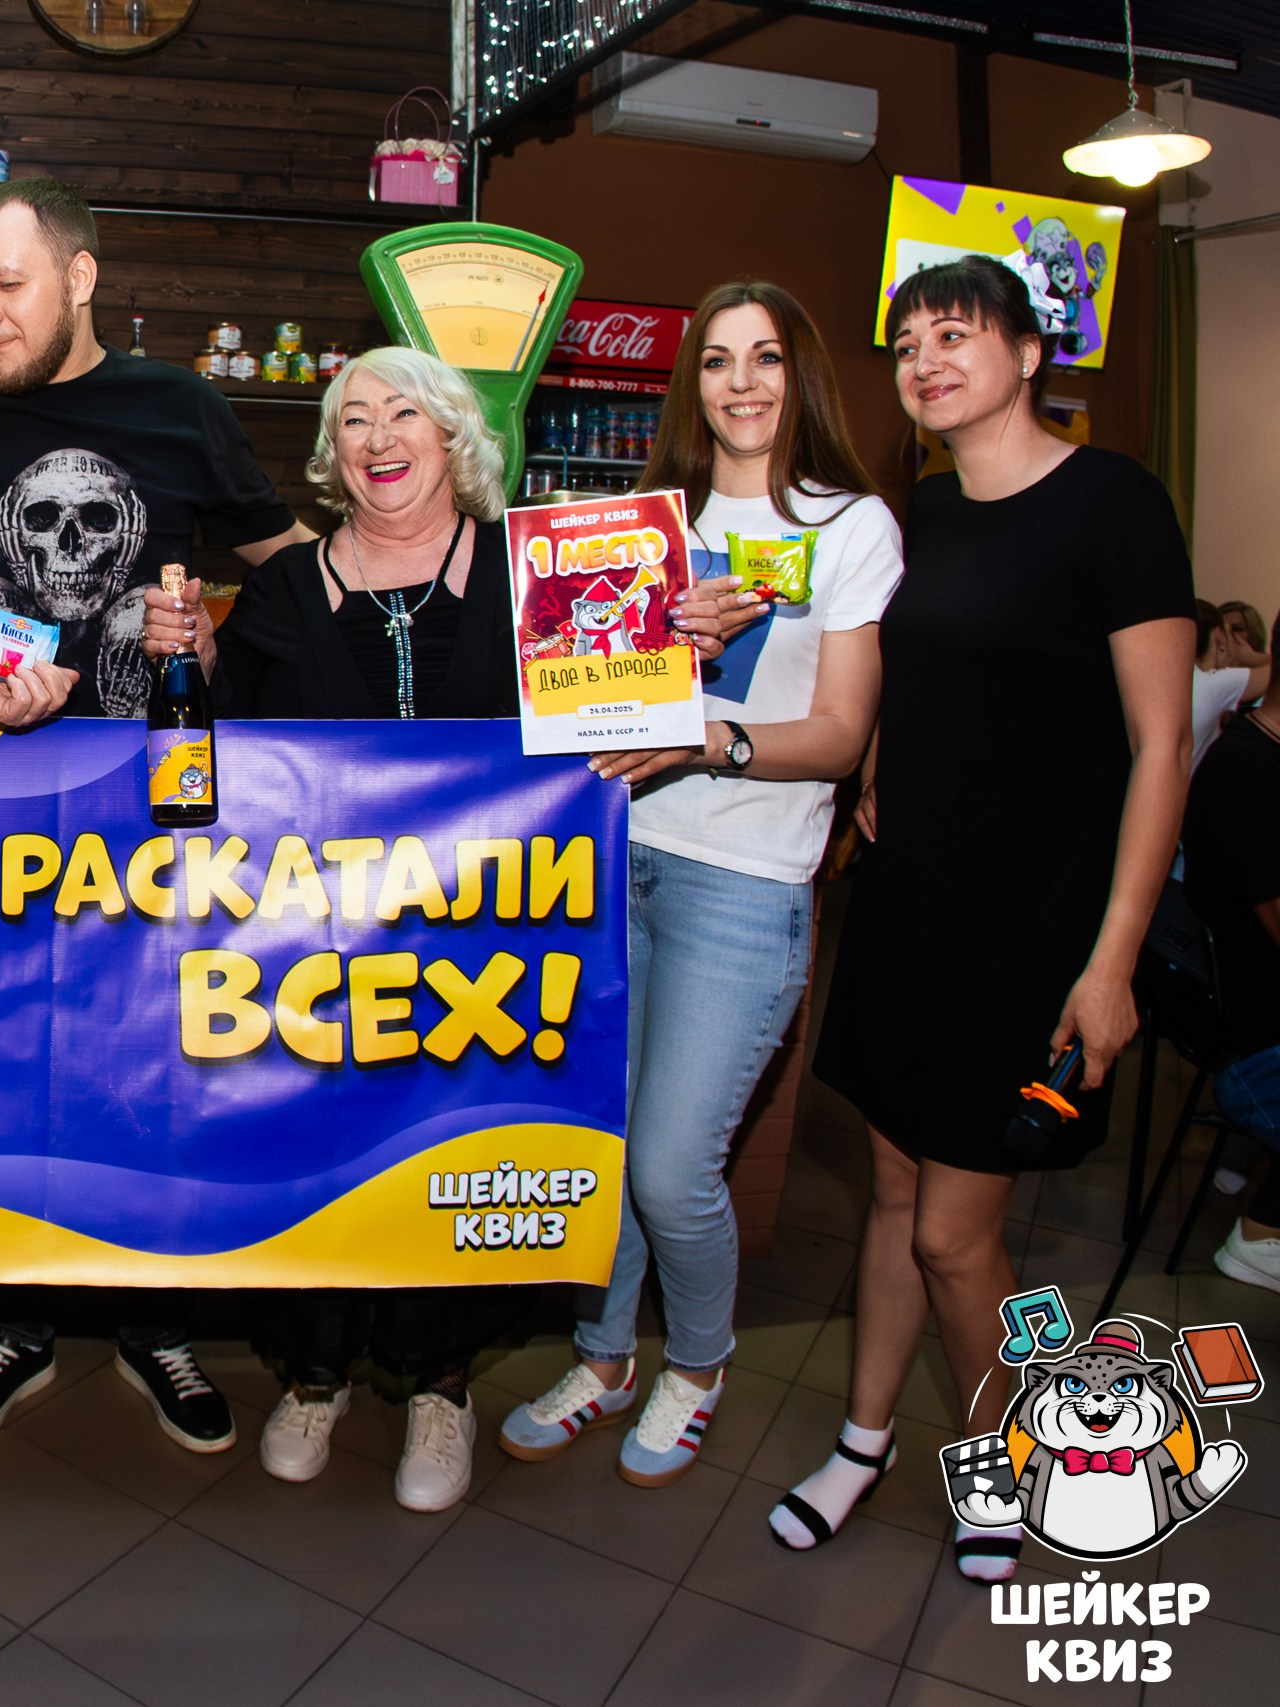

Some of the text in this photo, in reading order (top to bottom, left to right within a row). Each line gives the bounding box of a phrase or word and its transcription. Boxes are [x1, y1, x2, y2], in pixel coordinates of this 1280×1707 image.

[569, 377, 639, 392] 8-800-700-7777
[550, 508, 639, 529] ШЕЙКЕР КВИЗ
[528, 529, 668, 577] 1 МЕСТО
[589, 705, 634, 715] 24.04.2025
[577, 729, 605, 738] НАЗАД
[615, 727, 634, 737] СССР
[0, 832, 596, 926] РАСКАТАЛИ
[179, 949, 582, 1068] ВСЕХ!
[428, 1162, 597, 1209] ШЕЙКЕР
[454, 1212, 567, 1250] КВИЗ
